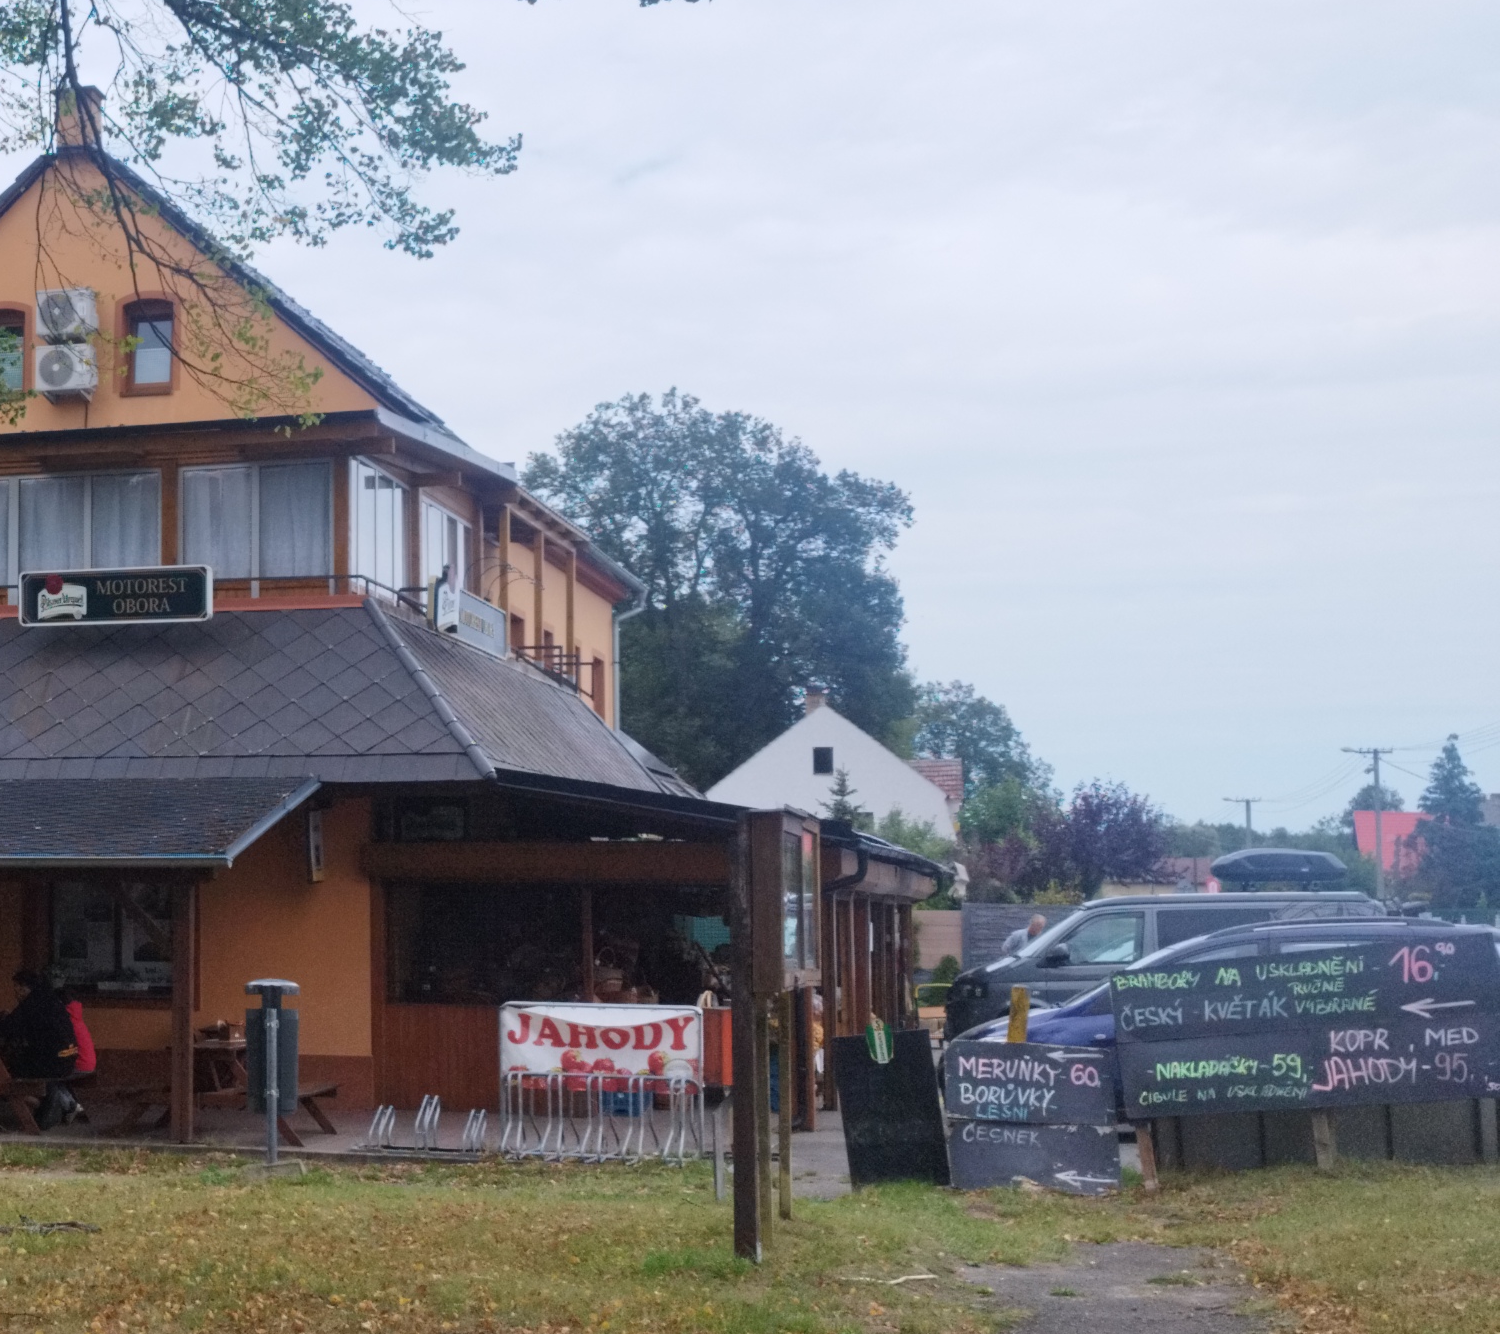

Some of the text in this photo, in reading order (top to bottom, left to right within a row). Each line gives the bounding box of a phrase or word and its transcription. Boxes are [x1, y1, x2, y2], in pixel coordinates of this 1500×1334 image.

[96, 577, 188, 595] MOTOREST
[112, 597, 172, 614] OBORA
[1215, 967, 1241, 987] NA
[1120, 990, 1288, 1031] ČESKÝ KVĚTÁK
[507, 1013, 695, 1050] JAHODY
[1424, 1027, 1479, 1046] MED
[959, 1082, 1056, 1117] BORŮVKY
[1197, 1089, 1216, 1101] NA
